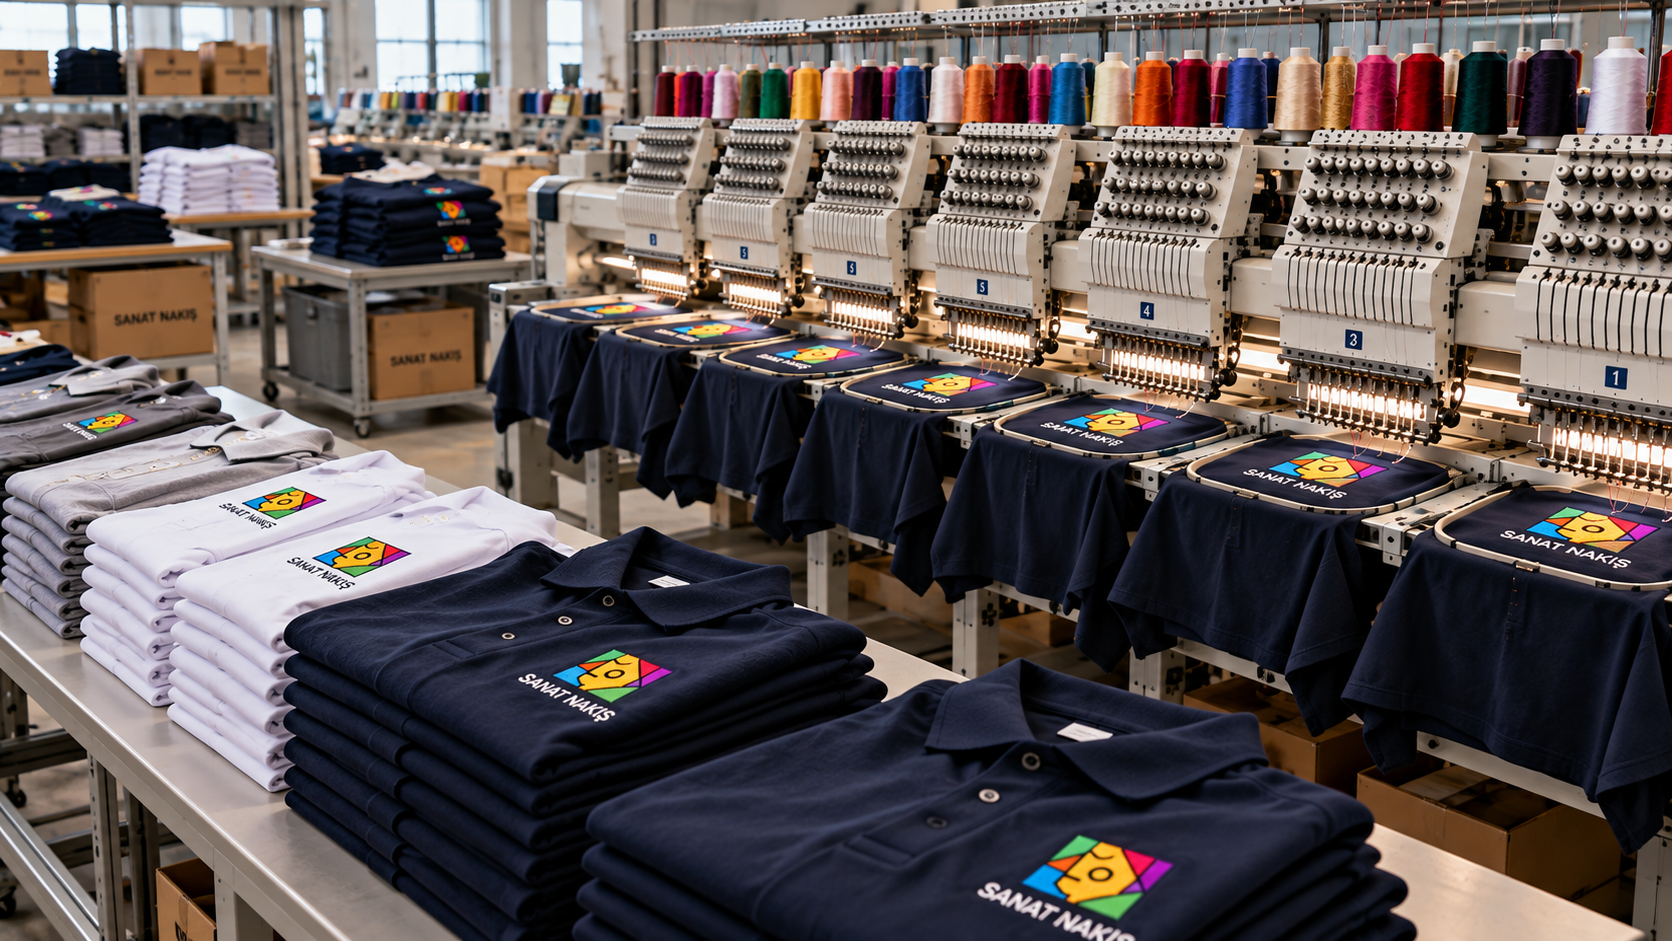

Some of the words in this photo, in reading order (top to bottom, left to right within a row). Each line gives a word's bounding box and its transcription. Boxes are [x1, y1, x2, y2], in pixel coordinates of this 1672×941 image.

[114, 311, 157, 327] SANAT
[160, 307, 197, 323] NAKIŞ
[1143, 304, 1151, 317] 4
[390, 352, 426, 368] SANAT
[1612, 370, 1619, 386] 1
[1243, 468, 1297, 485] SANAT
[1292, 480, 1347, 500] NAKIŞ
[1500, 530, 1565, 551] SANAT
[1565, 546, 1632, 569] NAKIŞ
[518, 673, 571, 699] SANAT
[563, 694, 616, 722] NAKIŞ
[976, 881, 1061, 921] SANAT
